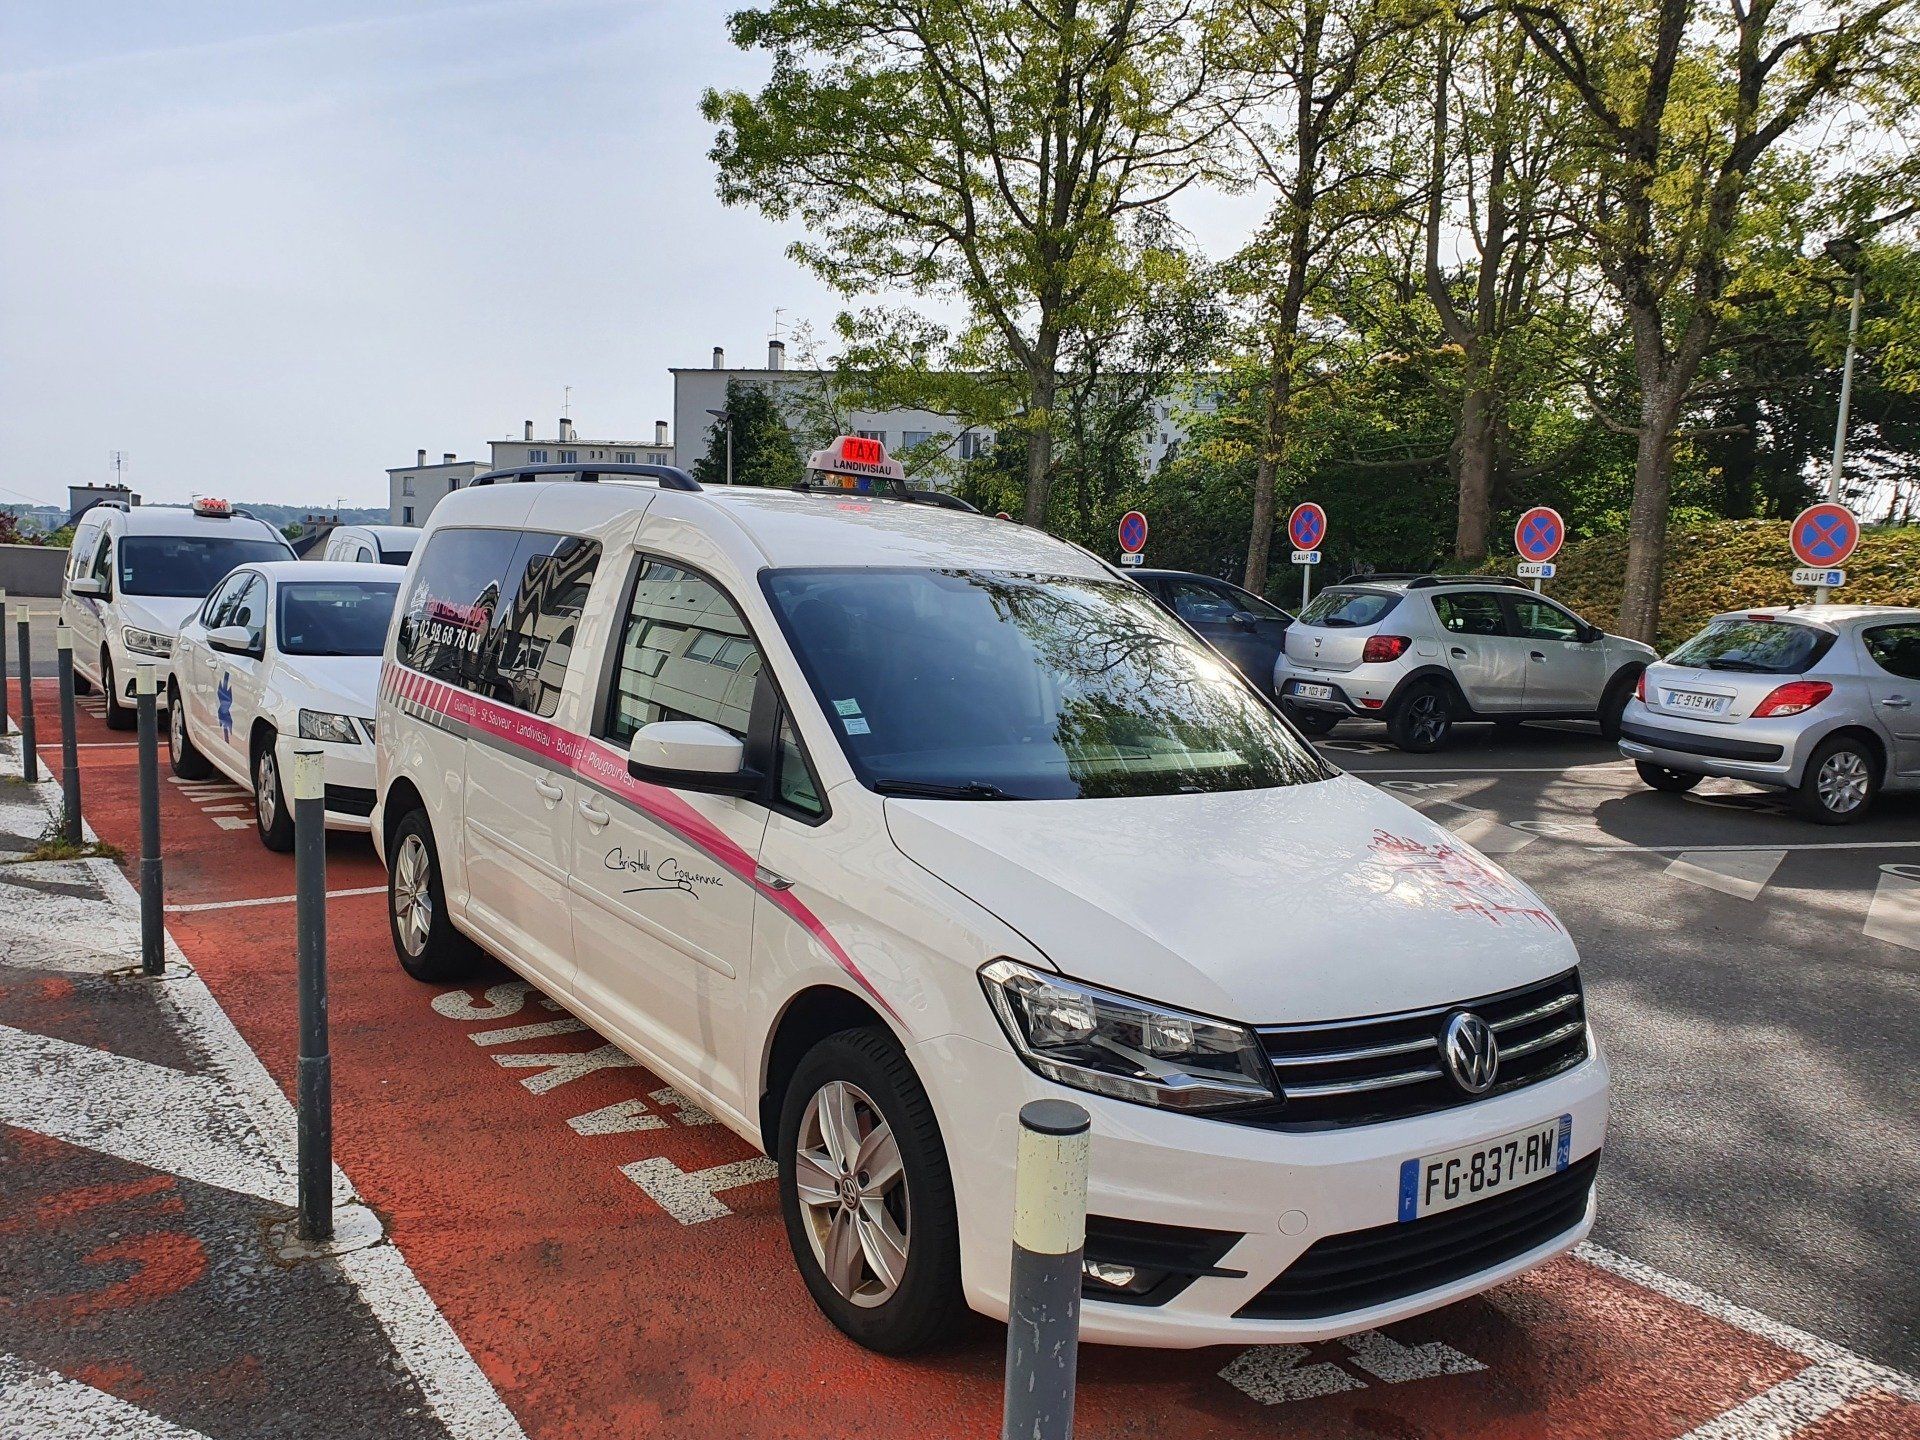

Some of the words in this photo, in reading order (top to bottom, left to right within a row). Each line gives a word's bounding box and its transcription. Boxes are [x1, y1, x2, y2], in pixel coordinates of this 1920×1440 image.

[846, 440, 882, 463] TAXI
[833, 459, 892, 475] LANDIVISIAU
[1520, 566, 1541, 574] SAUF
[1796, 572, 1826, 582] SAUF
[419, 619, 431, 639] 02
[430, 622, 442, 642] 98
[442, 625, 454, 646] 68
[454, 629, 468, 650] 78
[467, 632, 481, 653] 01
[488, 710, 512, 730] Sauveur
[516, 720, 550, 746] Landivisiau
[556, 738, 583, 759] Bodilis
[587, 751, 636, 788] Plougourvest
[604, 845, 651, 873] Christelle
[1557, 1145, 1569, 1165] 29
[1405, 1197, 1412, 1210] F
